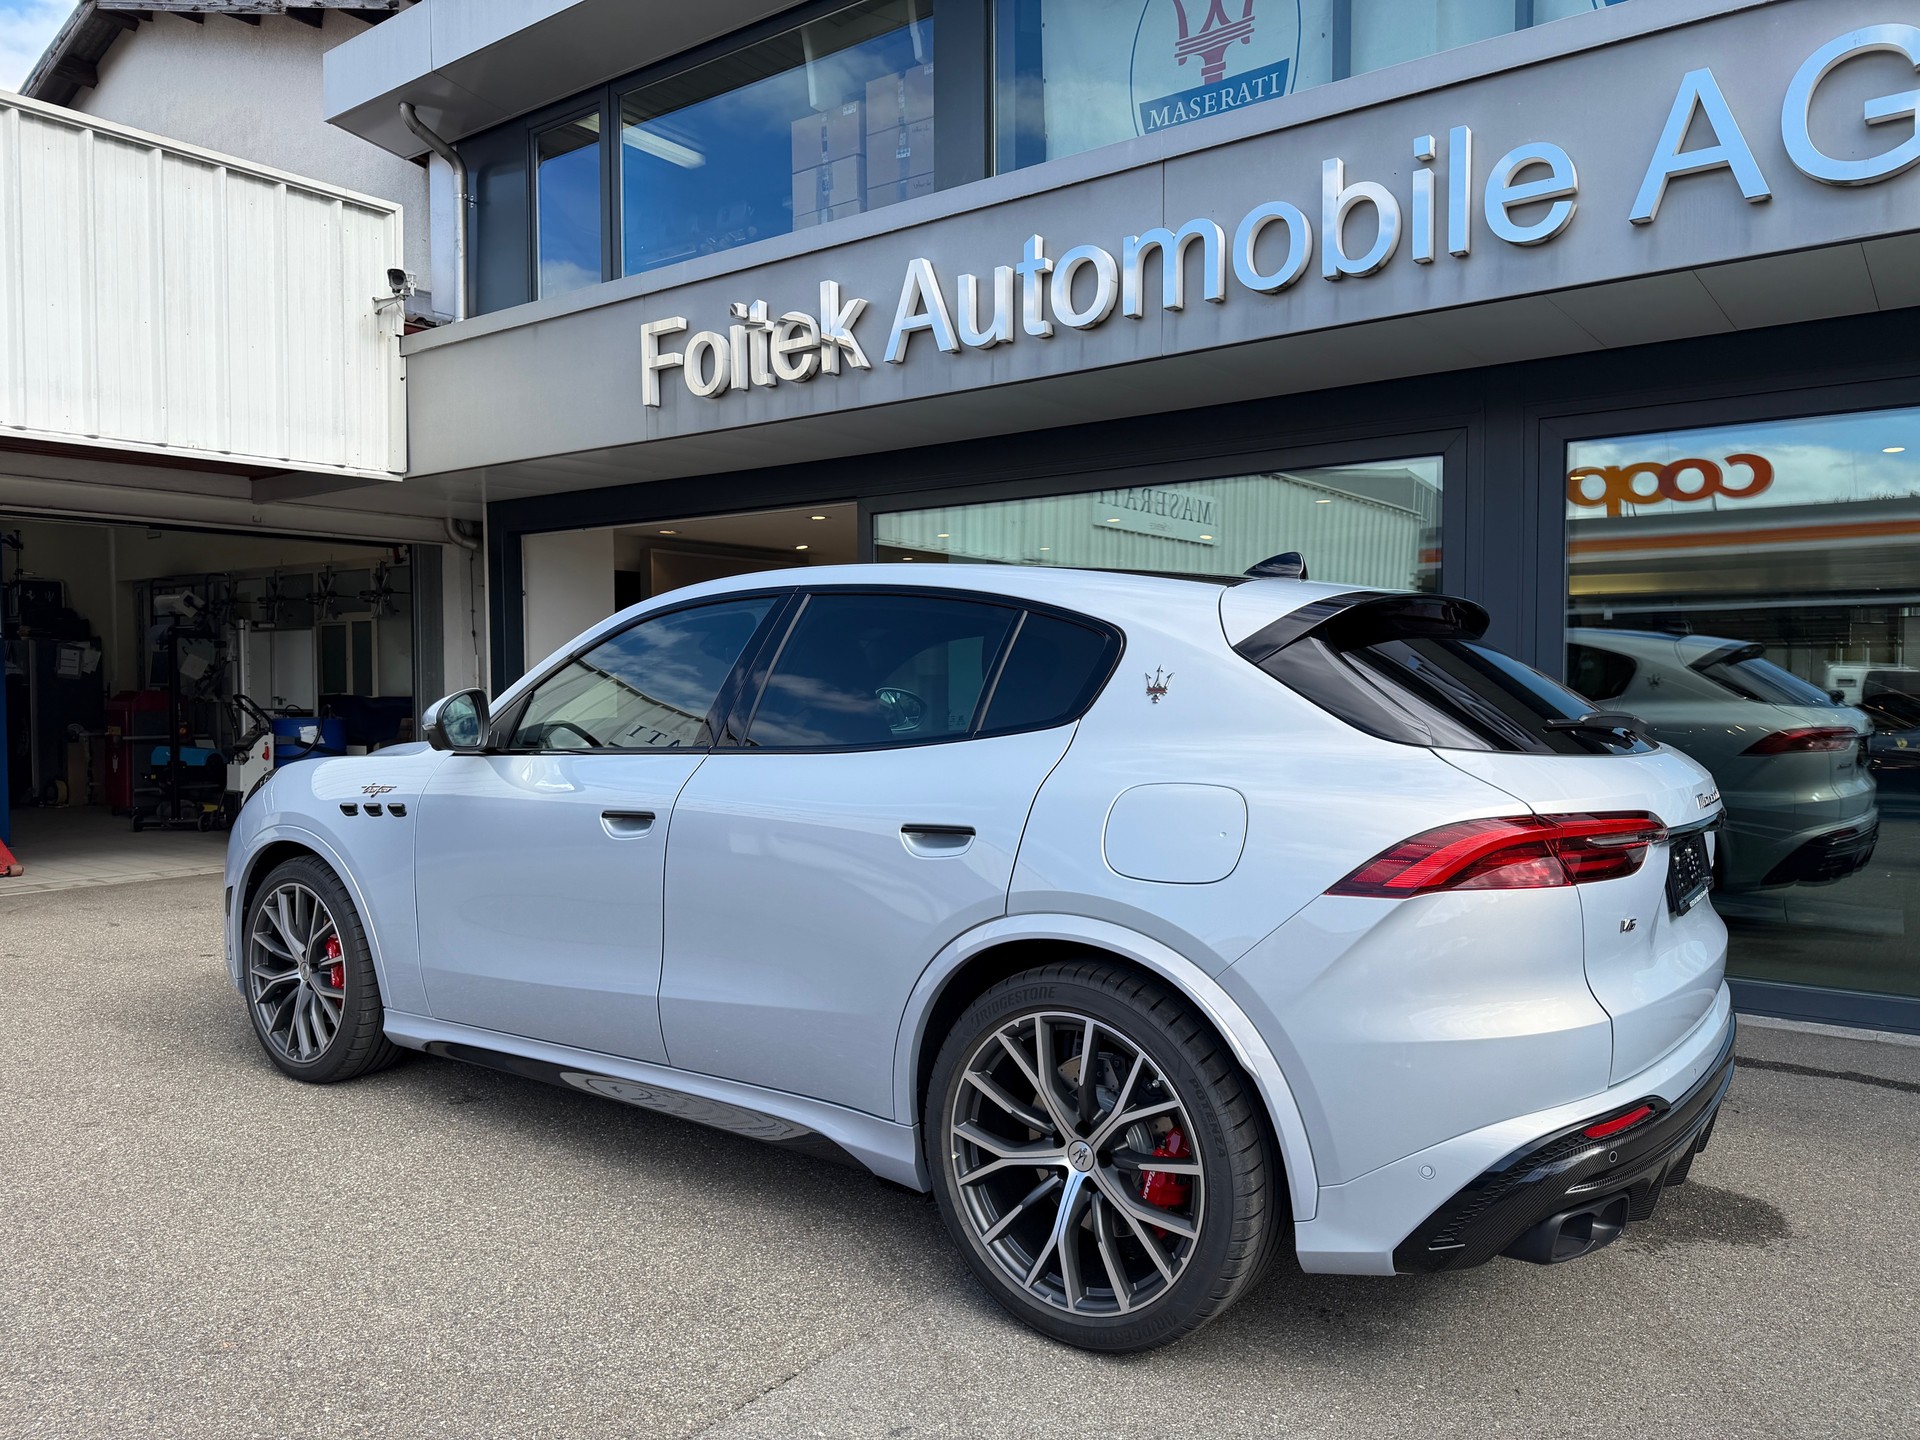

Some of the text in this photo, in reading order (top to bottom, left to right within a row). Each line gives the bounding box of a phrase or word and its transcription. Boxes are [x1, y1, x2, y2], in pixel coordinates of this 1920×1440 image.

[1148, 72, 1280, 130] MASERATI
[641, 23, 1920, 408] Foitek Automobile AG
[1189, 1078, 1227, 1159] POTENZA
